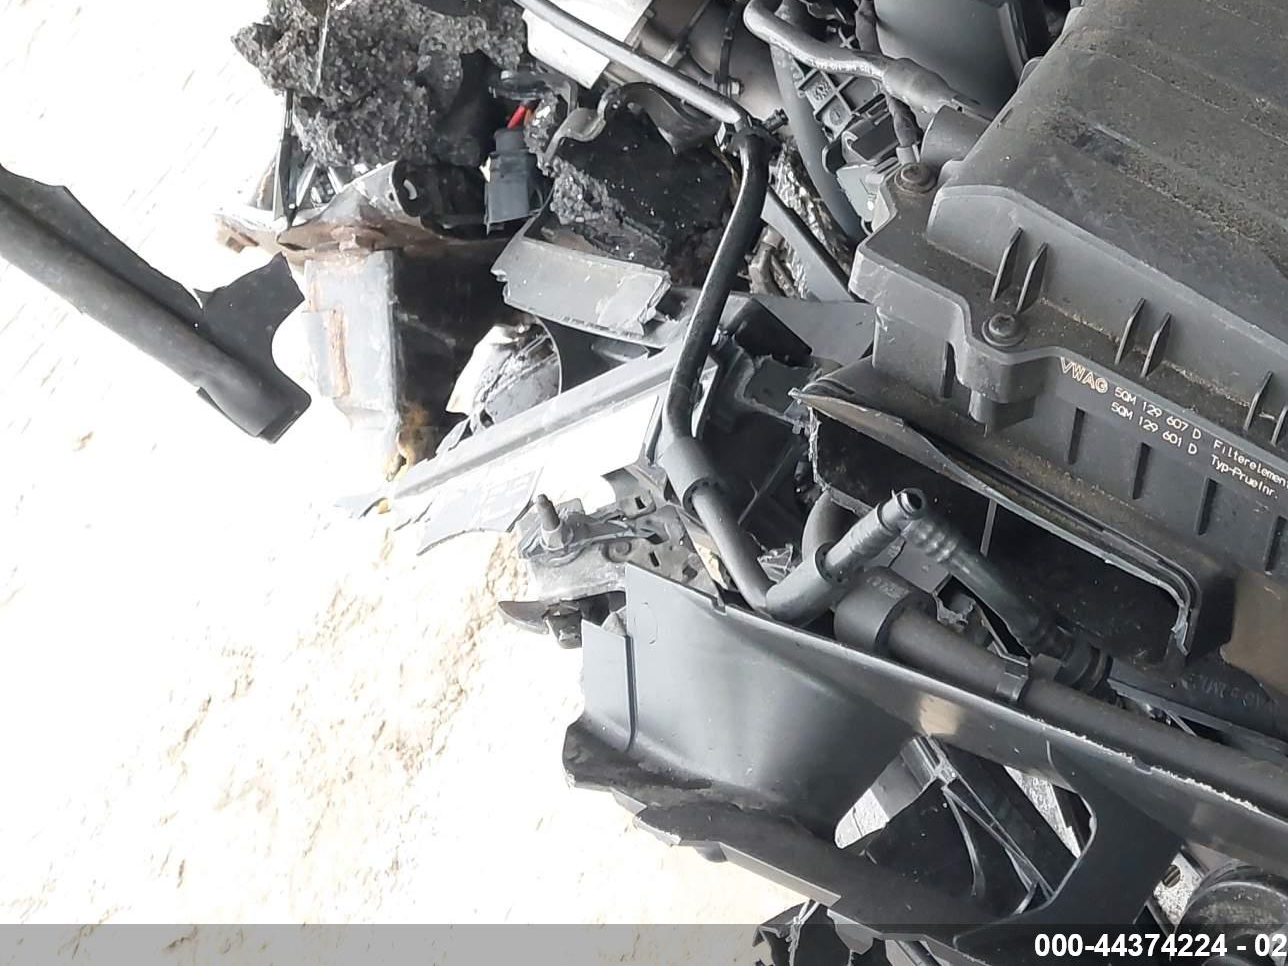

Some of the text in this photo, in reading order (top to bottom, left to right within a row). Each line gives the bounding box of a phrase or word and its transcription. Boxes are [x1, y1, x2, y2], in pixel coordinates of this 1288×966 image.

[1138, 415, 1159, 433] 129
[1162, 430, 1183, 448] 601
[1187, 442, 1198, 455] D
[1142, 401, 1163, 418] 129
[1166, 415, 1189, 432] 607
[1191, 427, 1202, 440] D
